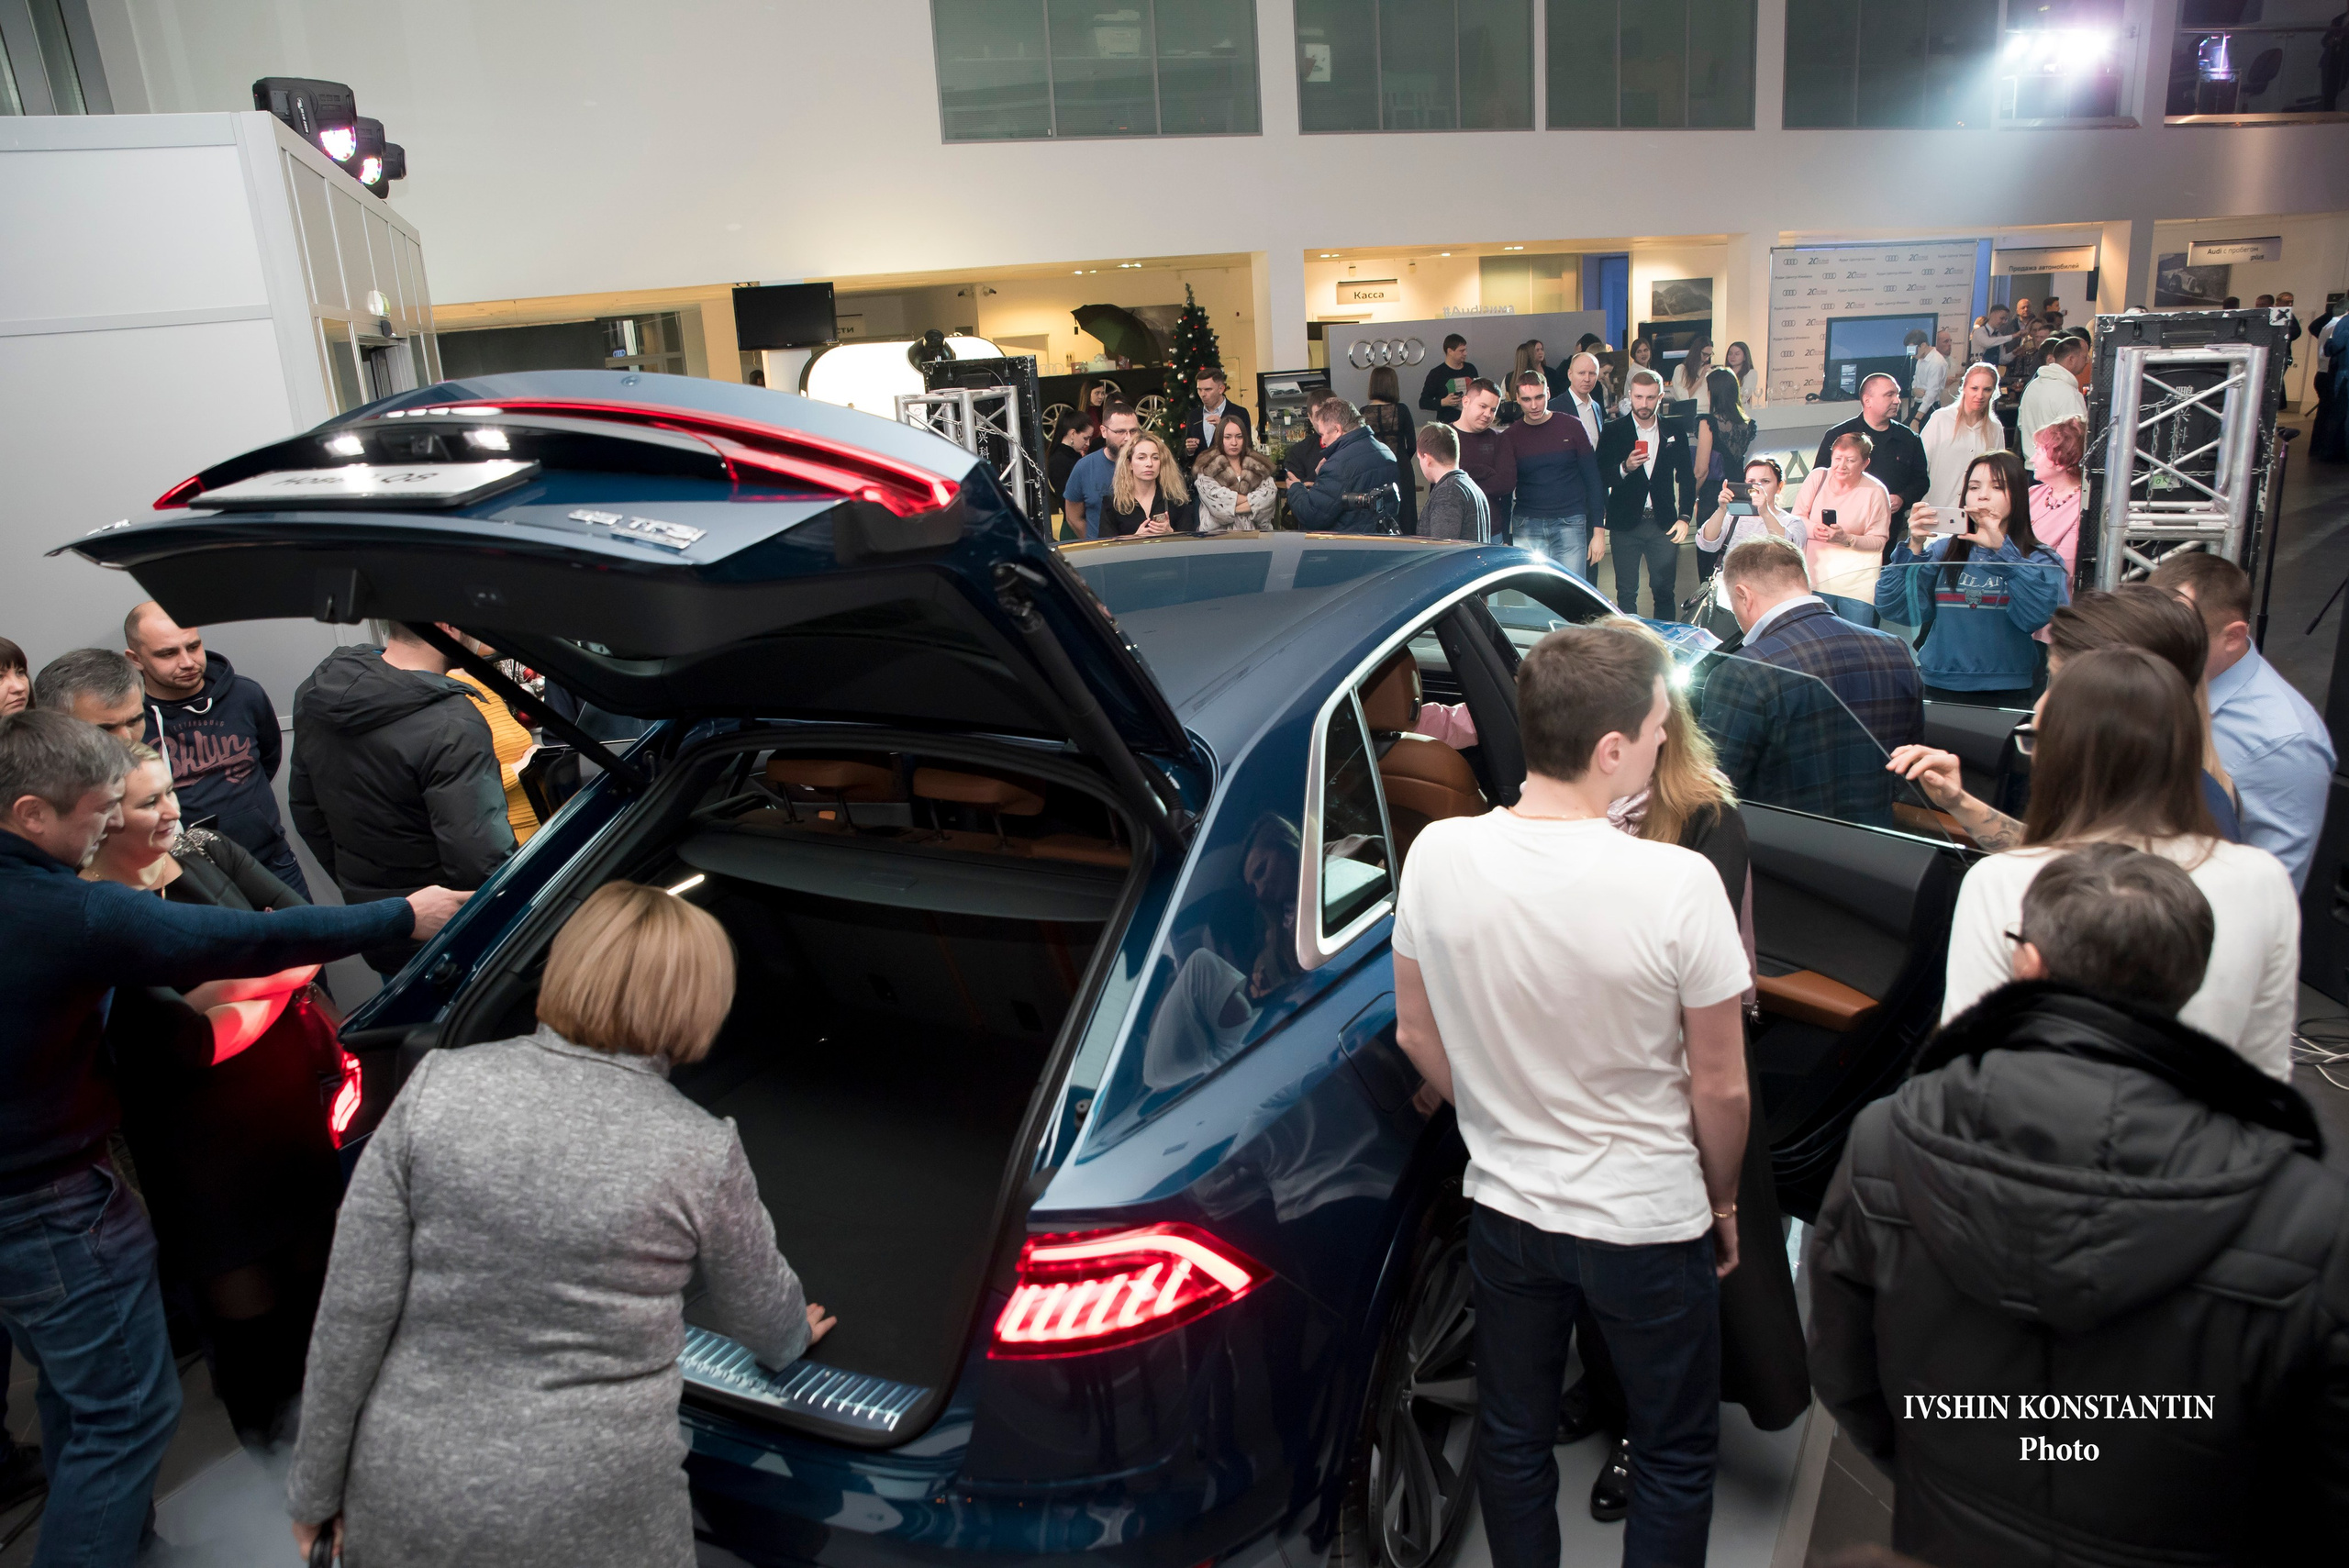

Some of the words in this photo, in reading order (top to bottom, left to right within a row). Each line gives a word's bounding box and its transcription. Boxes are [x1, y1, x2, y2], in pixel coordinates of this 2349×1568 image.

[1354, 291, 1384, 299] Касса
[1943, 572, 2008, 588] ILAN
[148, 730, 252, 780] Bklyn
